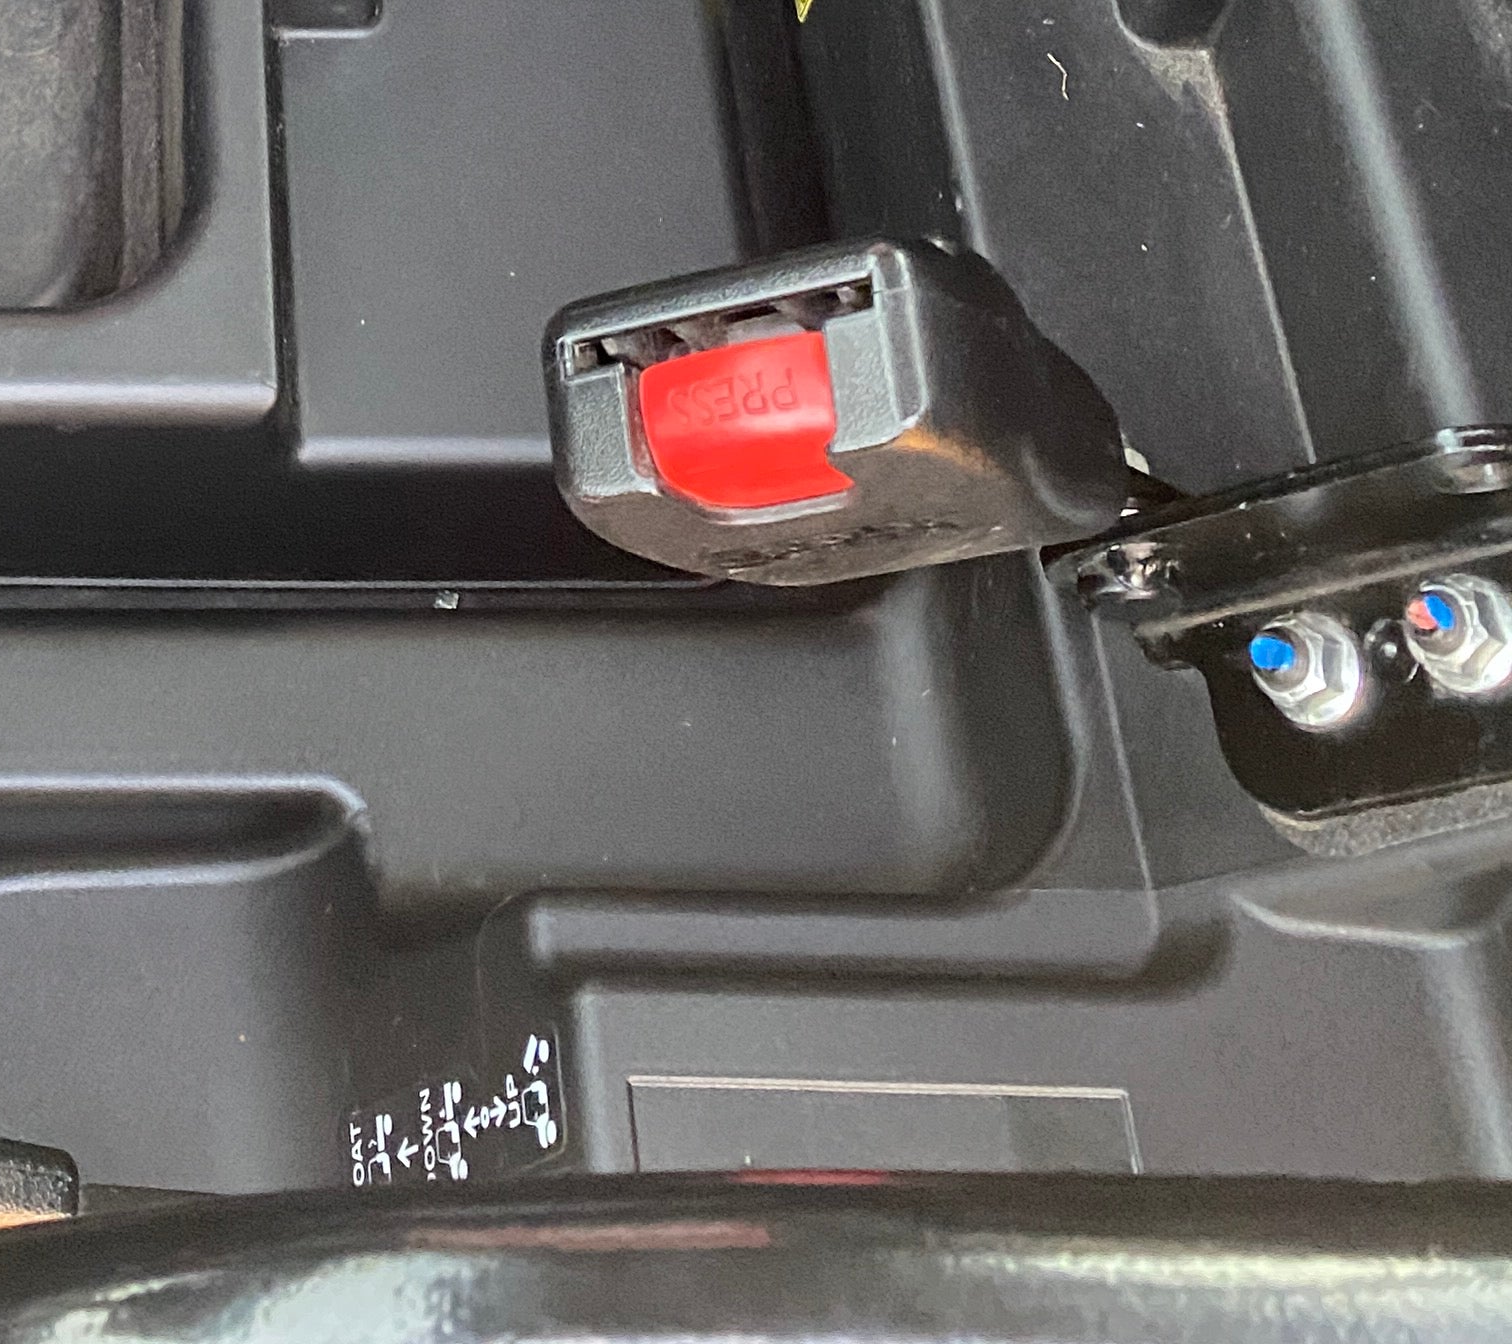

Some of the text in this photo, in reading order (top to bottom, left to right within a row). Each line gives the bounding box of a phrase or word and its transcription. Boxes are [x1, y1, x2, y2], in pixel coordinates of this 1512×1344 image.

[670, 367, 799, 427] PRESS
[505, 1073, 522, 1129] UP
[349, 1122, 365, 1187] OAT
